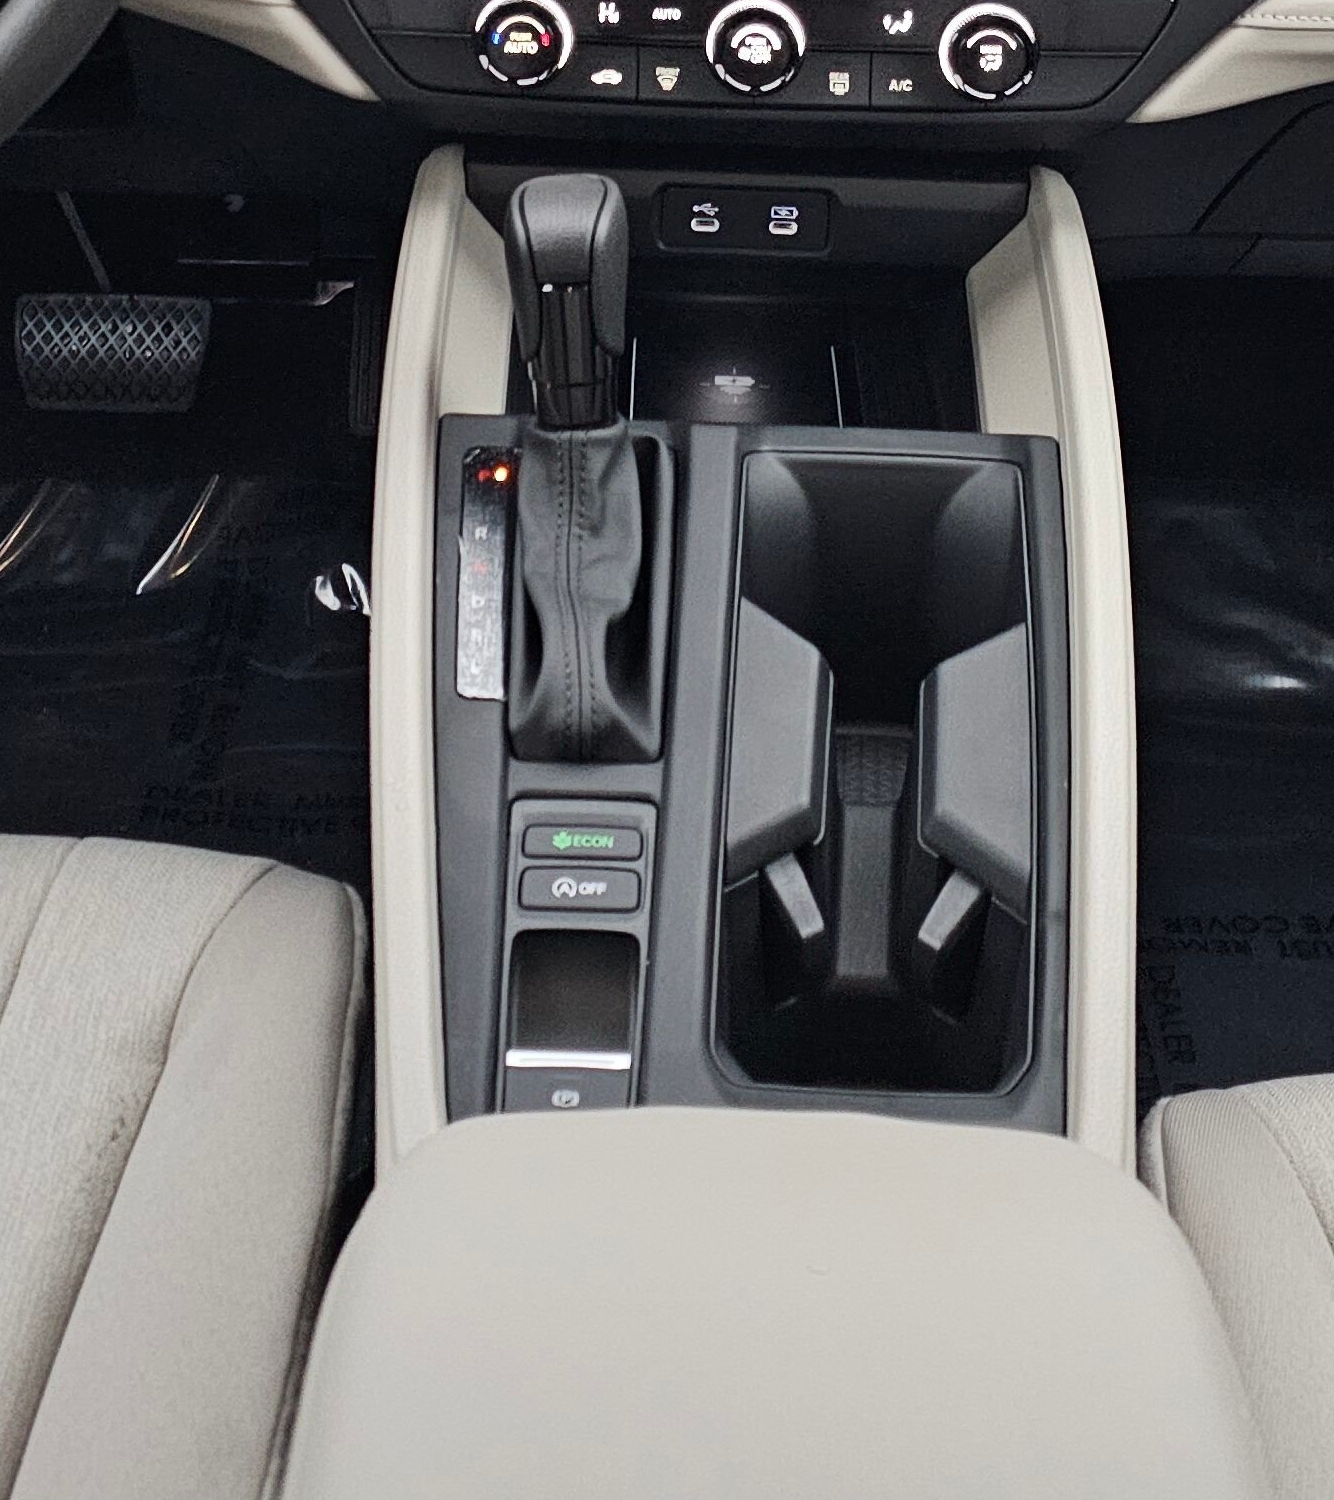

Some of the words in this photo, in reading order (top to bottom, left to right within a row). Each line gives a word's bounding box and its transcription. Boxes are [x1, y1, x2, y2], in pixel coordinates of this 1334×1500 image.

[652, 7, 682, 20] AUTO
[504, 41, 538, 54] AUTO
[888, 79, 913, 92] A/C
[474, 526, 487, 541] R
[573, 835, 614, 849] ECON
[578, 881, 607, 895] OFF
